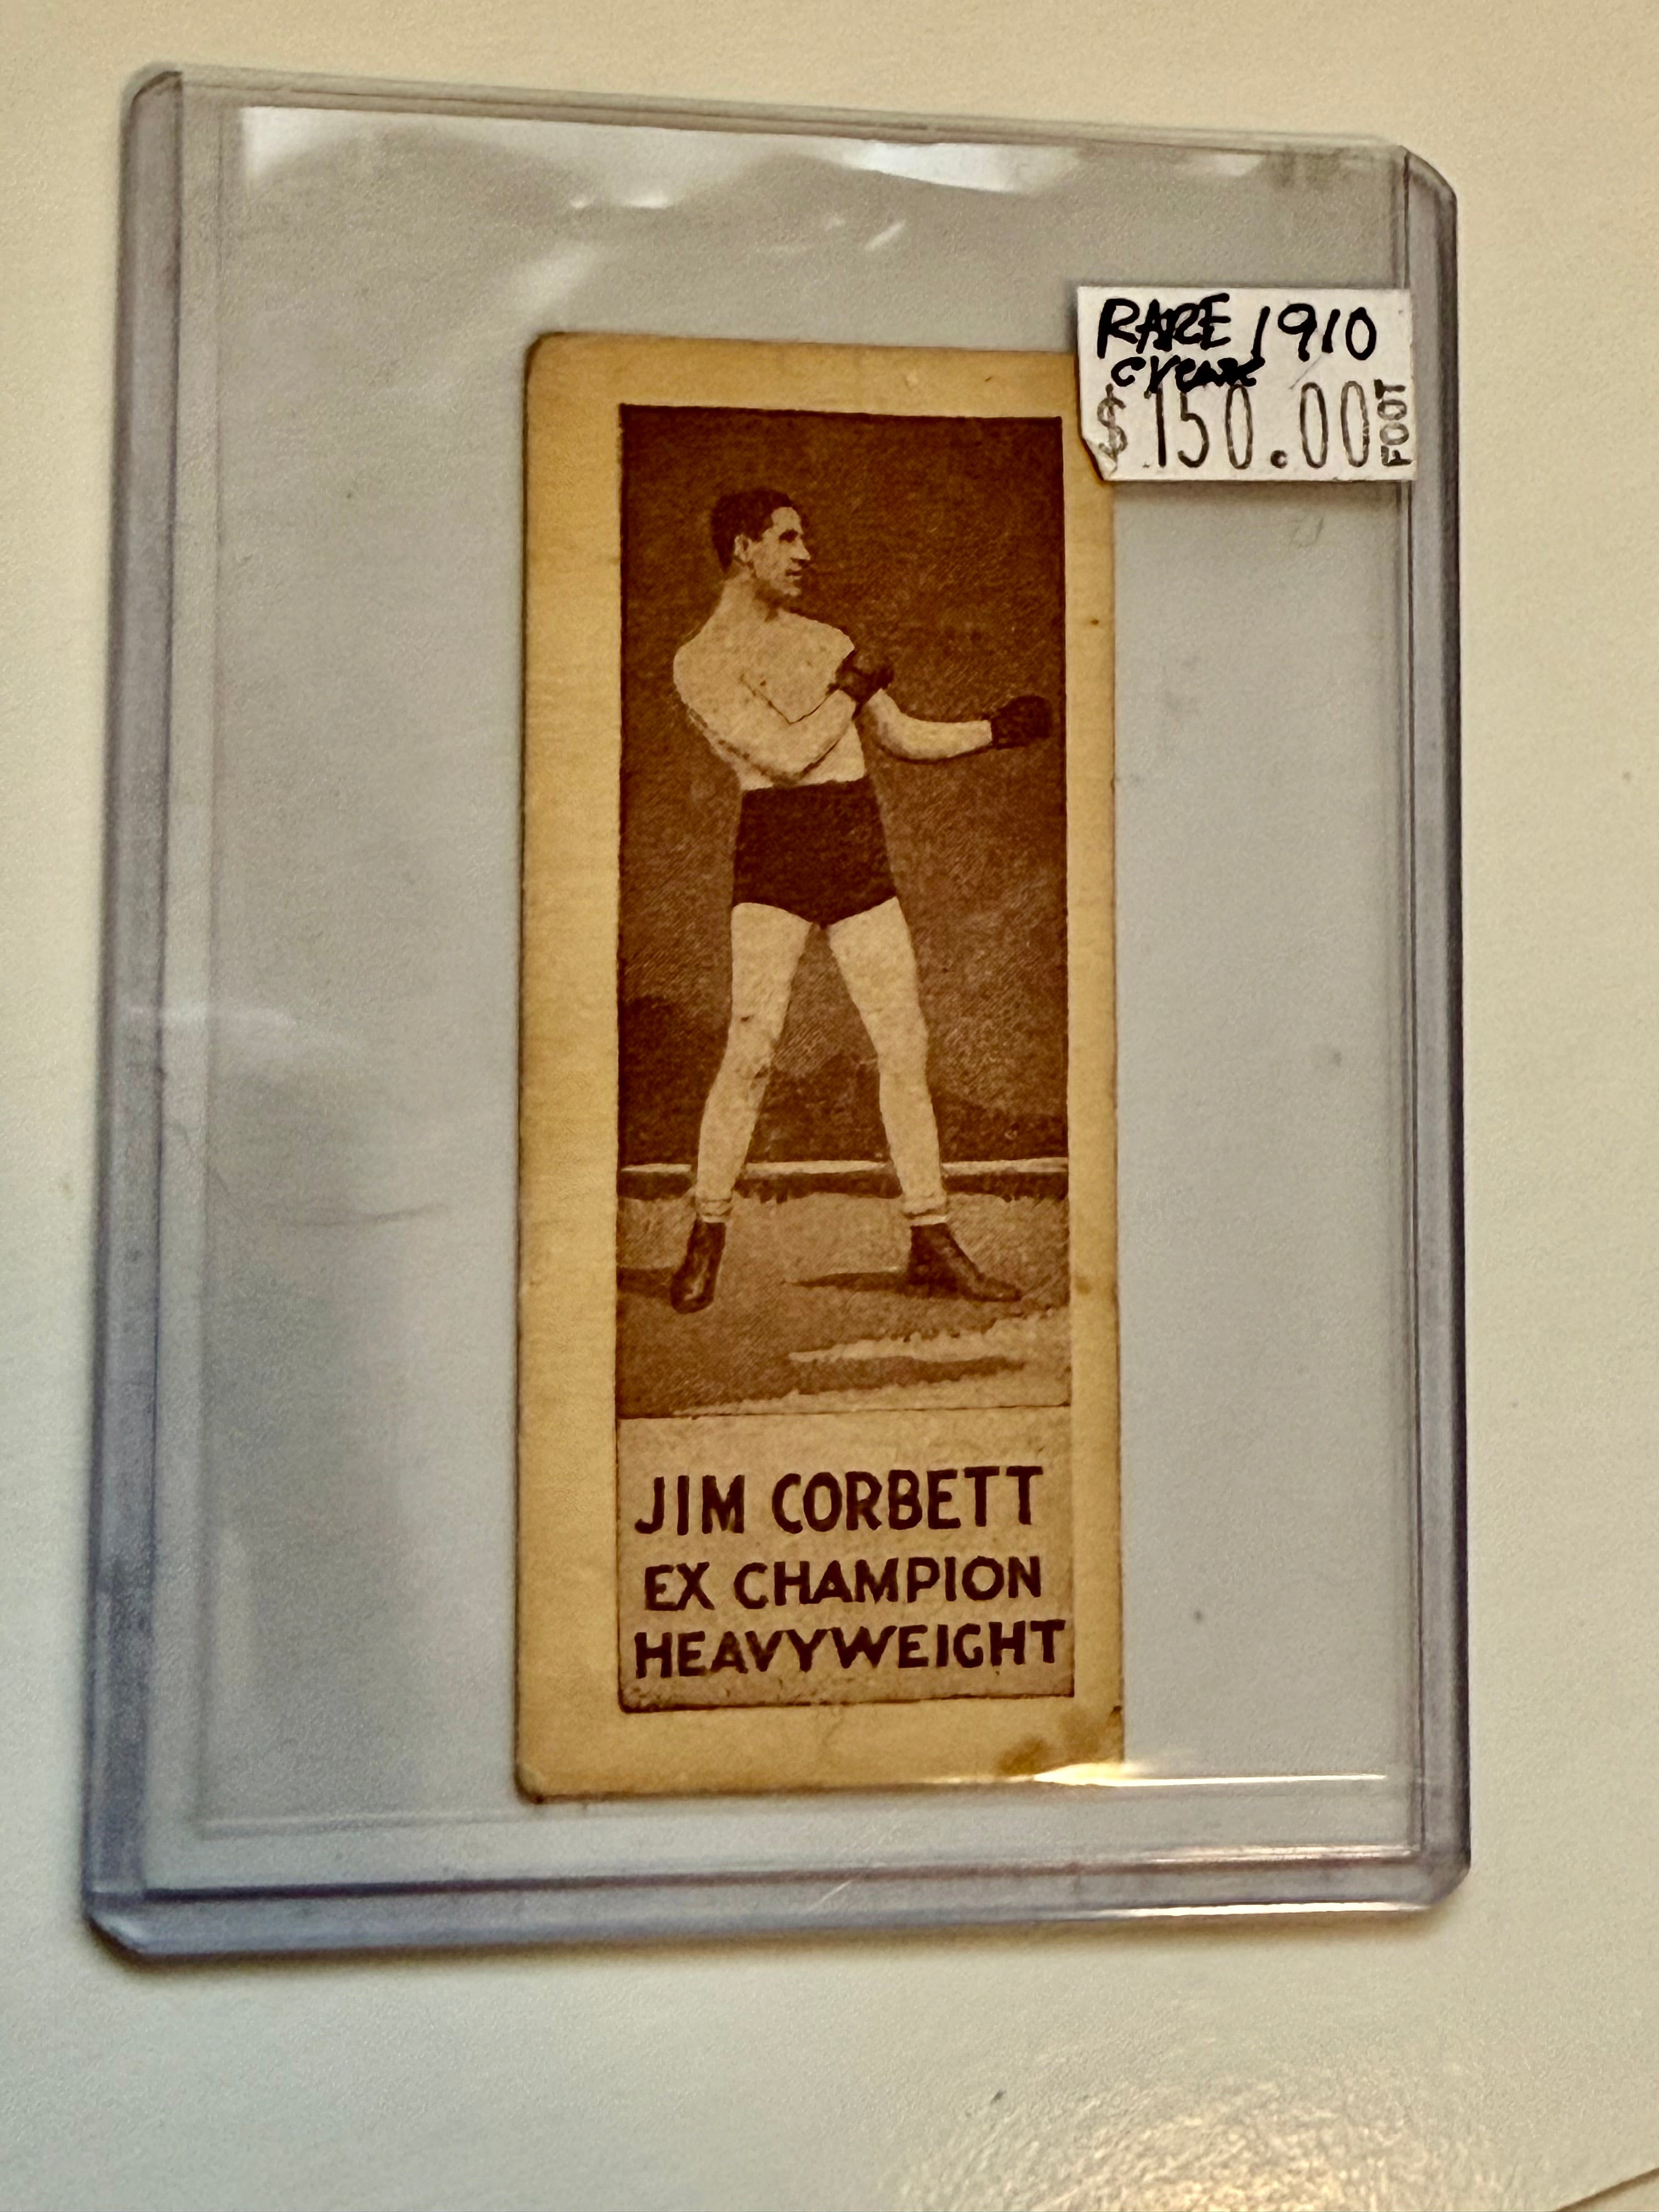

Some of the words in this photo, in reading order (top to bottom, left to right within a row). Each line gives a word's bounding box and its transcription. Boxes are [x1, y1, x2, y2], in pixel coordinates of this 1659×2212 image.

[1097, 293, 1231, 358] RARE
[1251, 303, 1377, 362] 1910
[1374, 379, 1413, 466] FOOT
[635, 1474, 745, 1536] JIM
[772, 1465, 1043, 1534] CORBETT
[644, 1561, 715, 1611] EX
[733, 1555, 1042, 1610] CHAMPION
[635, 1619, 1066, 1679] HEAVYWEIGHT
